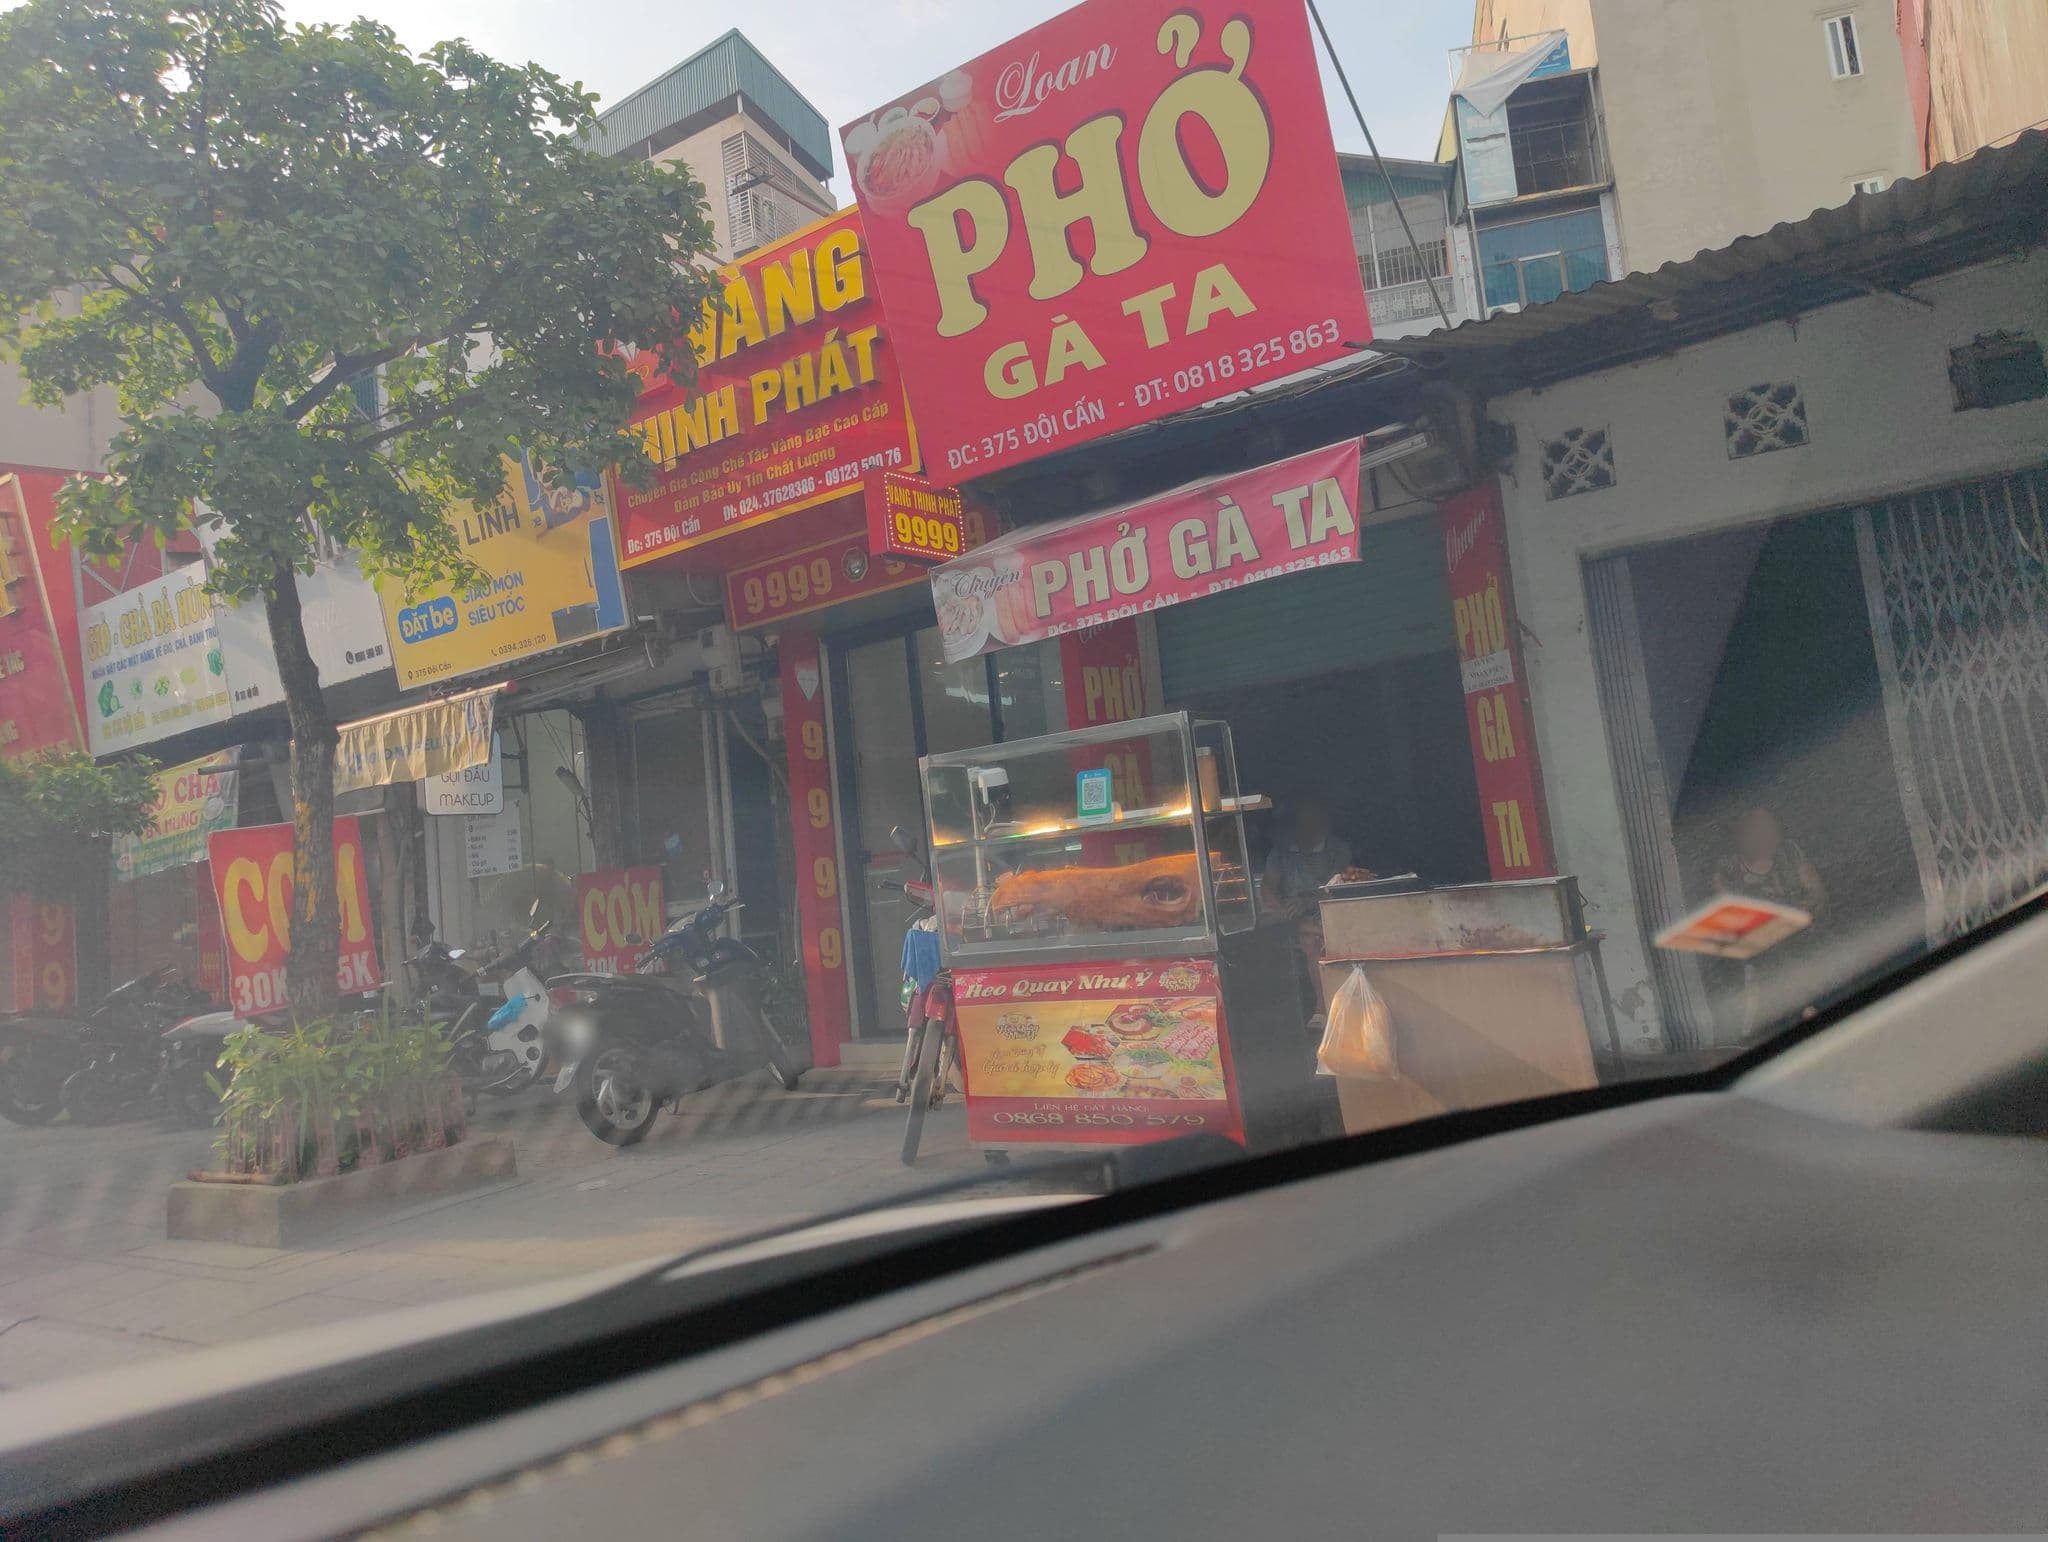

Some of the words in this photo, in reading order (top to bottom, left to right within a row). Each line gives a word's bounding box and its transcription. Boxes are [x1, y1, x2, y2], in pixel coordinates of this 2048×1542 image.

[993, 42, 1118, 123] Loan
[906, 13, 1272, 339] PHỞ
[984, 313, 1107, 400] GÀ
[1121, 262, 1257, 351] TA
[619, 385, 740, 473] HỊNH
[749, 325, 880, 426] PHÁT
[771, 434, 803, 456] Vàng
[805, 424, 831, 443] Bạc
[833, 414, 860, 432] Cao
[862, 399, 889, 422] Cấp
[948, 443, 979, 471] ĐC:
[983, 430, 1020, 460] 375
[1023, 413, 1060, 447] ĐỘI
[1063, 394, 1106, 433] CẤN
[1134, 379, 1171, 408] ĐT:
[1173, 354, 1236, 395] 0818
[1238, 338, 1286, 373] 325
[1289, 318, 1342, 358] 863
[463, 502, 521, 546] LINH
[645, 529, 662, 548] 375
[824, 461, 860, 487] 09123
[885, 446, 902, 467] 76
[895, 512, 959, 552] 9999
[1031, 521, 1150, 618] PHỞ
[1167, 495, 1260, 580] GÀ
[1272, 477, 1357, 549] TA
[1318, 546, 1352, 565] 863
[467, 604, 497, 626] SIÊU
[497, 591, 526, 617] TỐC
[743, 557, 832, 615] 9999
[1453, 569, 1506, 660] PHỞ
[402, 612, 429, 640] ĐẶT
[429, 604, 455, 630] be
[1082, 652, 1145, 721] PHỞ
[1476, 685, 1517, 763] GÀ
[1493, 799, 1531, 868] TA
[965, 982, 1007, 1000] Heo
[1012, 977, 1075, 998] Quay
[1078, 972, 1131, 991] Như
[992, 1111, 1066, 1127] 0868
[1075, 1111, 1135, 1127] 850
[1145, 1112, 1206, 1128] 579
